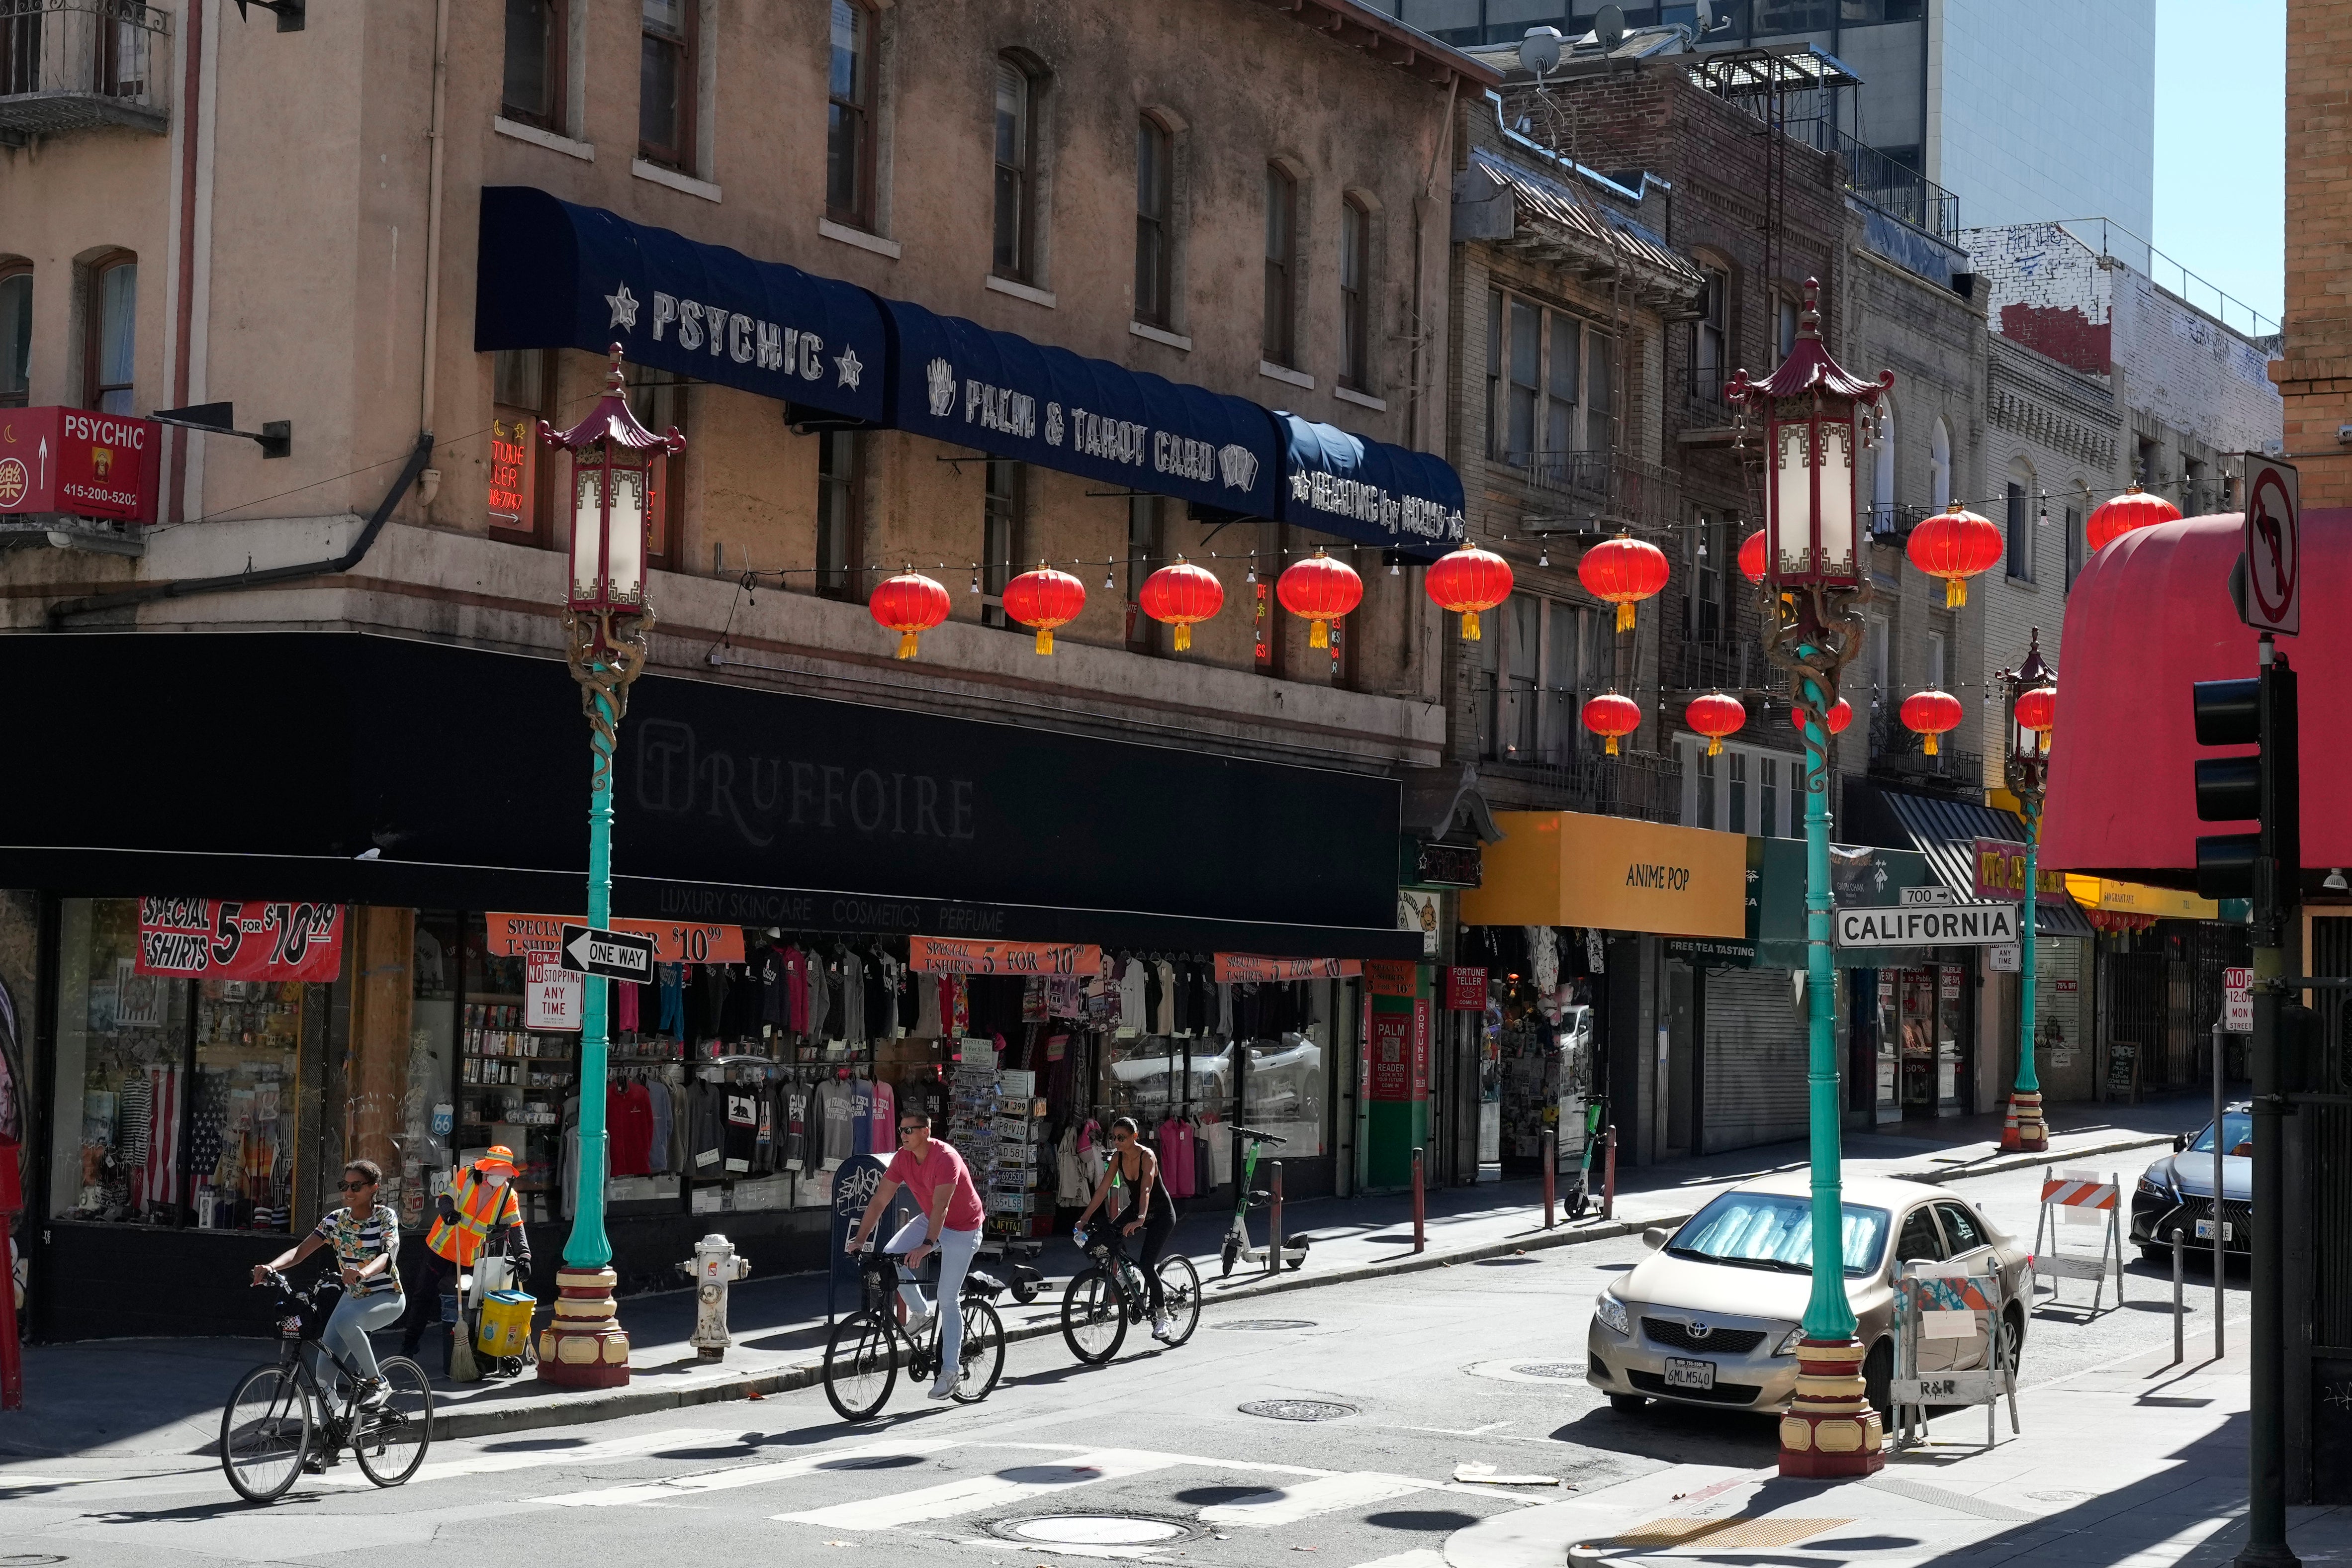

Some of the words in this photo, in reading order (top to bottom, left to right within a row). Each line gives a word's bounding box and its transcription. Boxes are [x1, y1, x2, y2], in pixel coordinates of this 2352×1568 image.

[653, 291, 823, 381] PSYCHIC
[65, 415, 144, 450] PSYCHIC
[966, 378, 1035, 438] PALM
[1045, 401, 1065, 446] &
[1072, 407, 1148, 466] TAROT
[1154, 430, 1216, 481] CARD
[64, 483, 137, 506] 415-200-5202
[1626, 863, 1665, 889] ANIME
[1668, 867, 1689, 891] POP
[1746, 869, 1759, 883] 茶
[1850, 883, 1864, 893] CHAK
[1907, 890, 1931, 902] 700
[2111, 893, 2126, 904] GRANT
[2126, 895, 2135, 904] AVE
[142, 896, 210, 930] SPECIAL
[660, 888, 724, 916] LUXURY
[729, 893, 812, 921] SKINCARE
[832, 899, 921, 928] COSMETICS
[939, 907, 1004, 933] PERFUME
[1403, 892, 1421, 919] BUDDHA
[508, 919, 564, 936] SPECIA
[1844, 912, 2010, 939] CALIFORNIA
[211, 902, 243, 965] 5
[242, 919, 263, 933] FOR
[142, 931, 209, 971] T-SHIRTS
[590, 943, 614, 963] ONE
[619, 948, 643, 967] WAY
[926, 942, 970, 956] SPECIAL
[1670, 941, 1694, 951] FREE
[1696, 943, 1714, 953] TEA
[1716, 945, 1755, 957] TASTING
[925, 959, 975, 974] T-SHIRTS
[983, 947, 996, 974] 5
[1007, 951, 1039, 970] FOR
[1226, 956, 1262, 968] SPECIAL
[1289, 959, 1314, 976] FOR
[529, 965, 543, 982] NO
[544, 969, 580, 983] STOPPING
[1453, 968, 1485, 977] FORTUNE
[2227, 971, 2243, 986] NO
[1367, 981, 1374, 991] 5
[1456, 977, 1481, 986] TELLER
[544, 987, 565, 1000] ANY
[542, 1002, 566, 1015] TIME
[2232, 1008, 2248, 1017] MON
[1378, 1023, 1405, 1036] PALM
[2111, 1045, 2136, 1058] JADE
[1377, 1063, 1405, 1072] READER
[1416, 1079, 1426, 1088] TELLER
[1013, 1102, 1026, 1111] 399
[435, 1115, 450, 1131] 66
[1010, 1148, 1024, 1158] 581
[1008, 1198, 1021, 1208] LSB
[1668, 1369, 1710, 1385] 6MLM540
[1920, 1380, 1956, 1395] R&R
